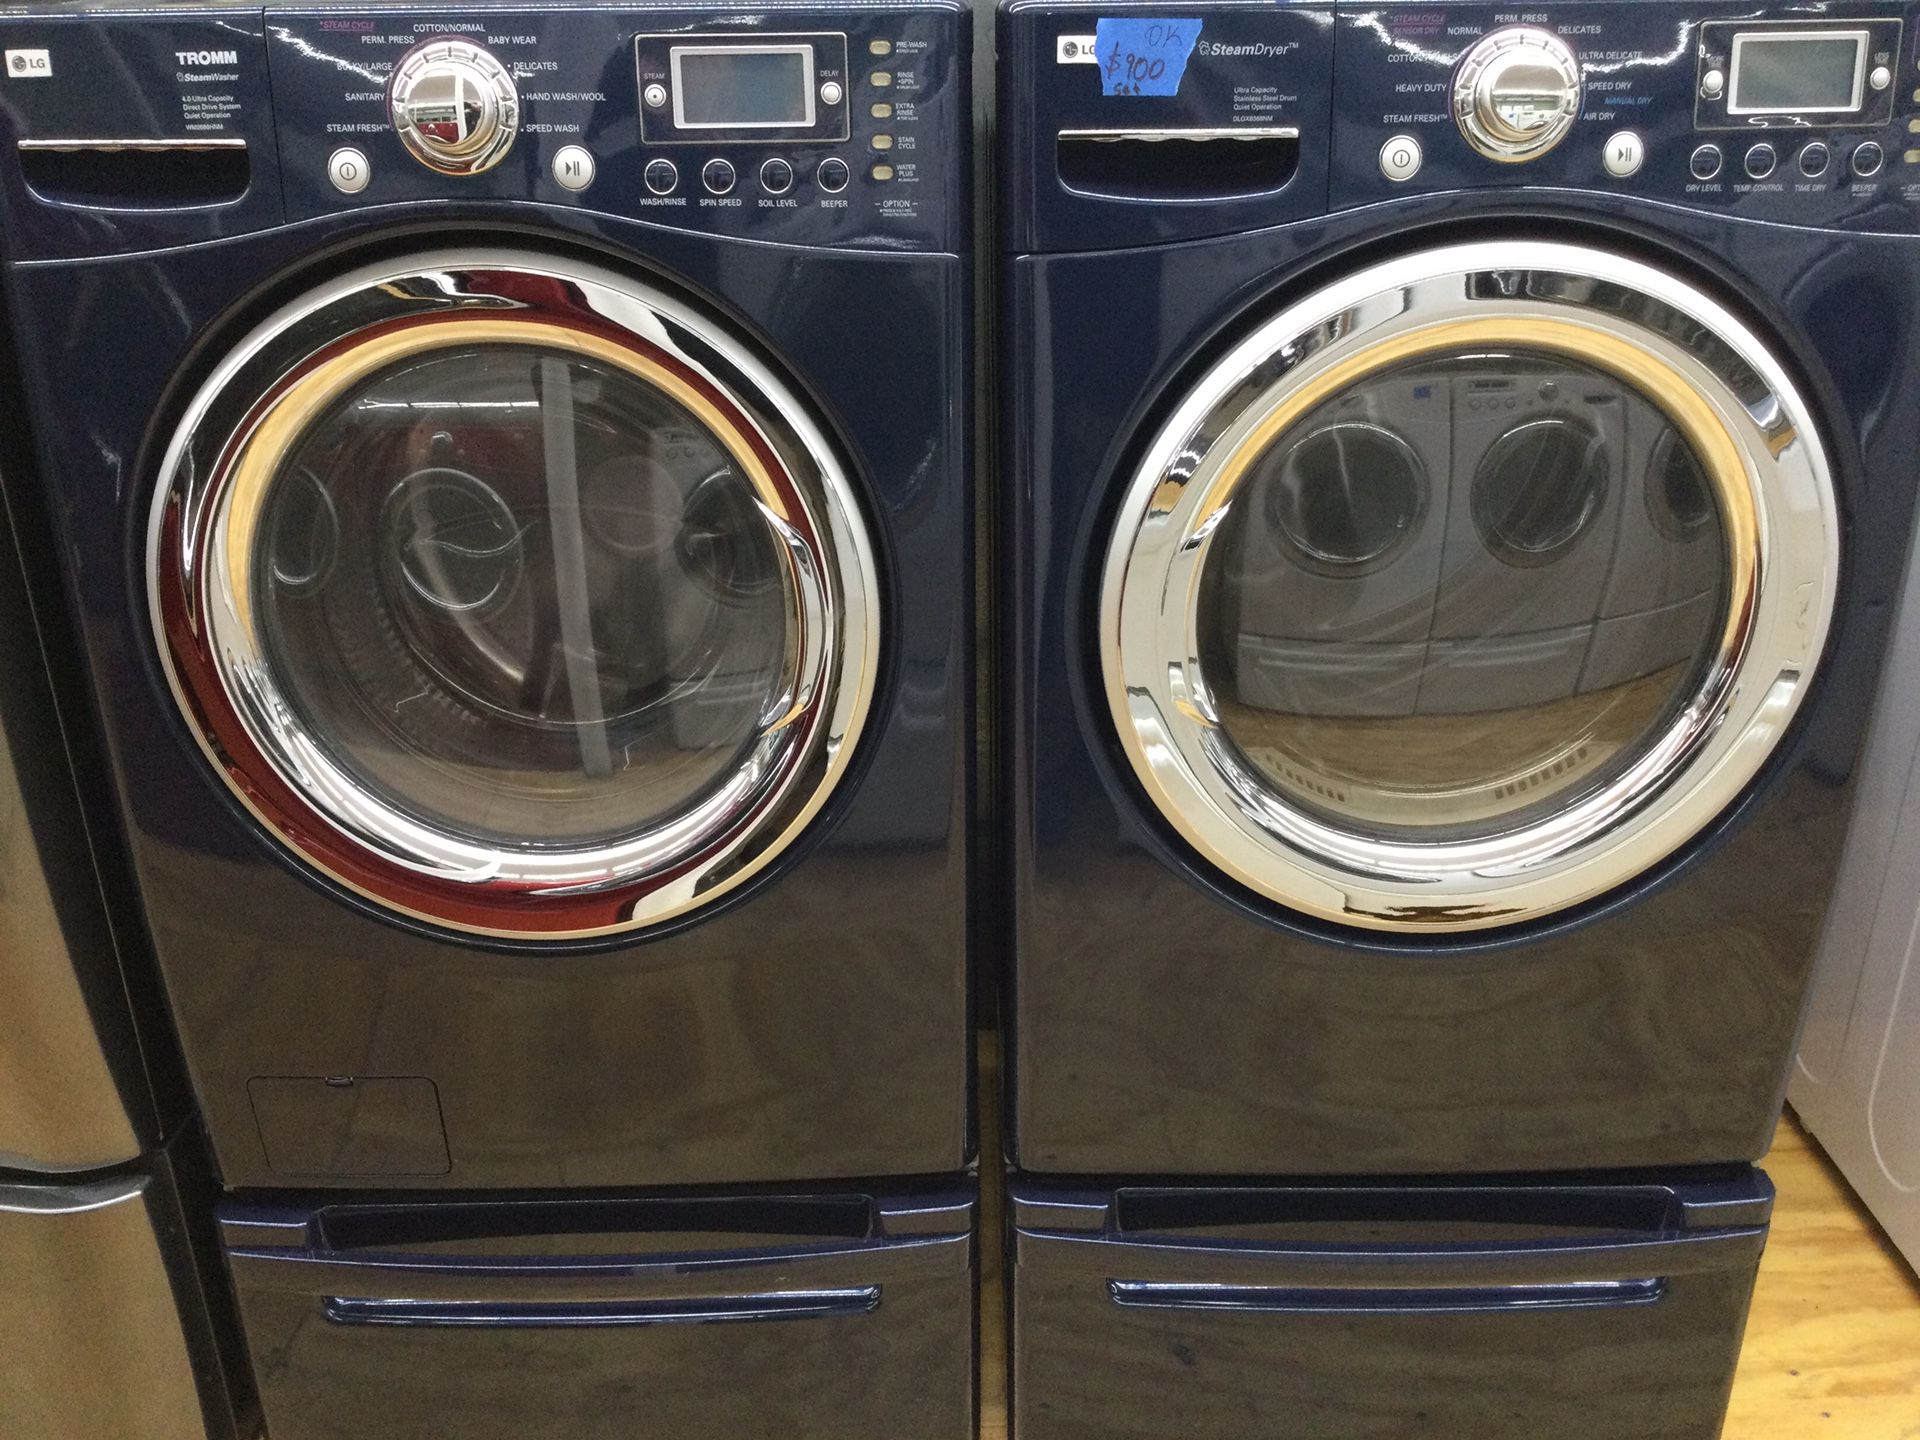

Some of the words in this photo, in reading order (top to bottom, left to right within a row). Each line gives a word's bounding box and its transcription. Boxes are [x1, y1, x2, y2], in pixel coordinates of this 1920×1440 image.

[1521, 14, 1548, 23] PRESS
[351, 21, 376, 29] CYCLE
[413, 23, 486, 33] COTTON/NORMAL
[1447, 26, 1483, 35] NORMAL
[1558, 26, 1601, 35] DELICATES
[361, 35, 387, 45] PERM.
[388, 35, 415, 45] PRESS
[488, 35, 510, 45] BABY
[511, 35, 537, 45] WEAR
[1144, 25, 1182, 48] OK
[175, 50, 238, 66] TROMM
[1578, 51, 1602, 60] ULTRA
[30, 59, 46, 69] LG
[1105, 40, 1165, 81] $900
[513, 62, 558, 71] DELICATES
[184, 72, 239, 83] SteamWasher
[643, 72, 665, 80] STEAM
[819, 69, 839, 77] DELAY
[1250, 86, 1278, 94] Capacity
[1395, 84, 1423, 93] HEAVY
[1424, 83, 1447, 92] DUTY
[1588, 82, 1614, 91] SPEED
[1614, 82, 1632, 91] DRY
[208, 94, 234, 102] Capacity
[345, 92, 385, 102] SANITARY
[526, 92, 551, 102] HAND
[551, 92, 606, 102] WASH/WOOL
[1279, 94, 1297, 102] Drum
[1604, 97, 1635, 105] MANUAL
[1636, 97, 1653, 105] DRY
[182, 103, 201, 111] Direct
[218, 102, 242, 111] System
[1233, 103, 1250, 111] Quiet
[1251, 103, 1282, 111] Operation
[201, 111, 231, 119] Operation
[1383, 115, 1409, 123] STEAM
[1583, 113, 1597, 121] AIR
[1598, 112, 1616, 121] DRY
[326, 123, 353, 133] STEAM
[526, 124, 555, 133] SPEED
[555, 124, 580, 133] WASH
[1685, 184, 1700, 192] DRY
[1701, 184, 1723, 192] LEVEL
[1752, 184, 1784, 192] CONTROL
[1795, 184, 1811, 192] TIME
[1811, 184, 1827, 192] DRY
[1851, 184, 1878, 192] BEEPER
[639, 197, 687, 207] WASH/RINSE
[699, 198, 718, 207] SPIN
[718, 198, 742, 207] SPEED
[758, 199, 775, 208] SOIL
[776, 199, 798, 208] LEVEL
[820, 199, 849, 208] BEEPER
[882, 200, 911, 208] OPTION
